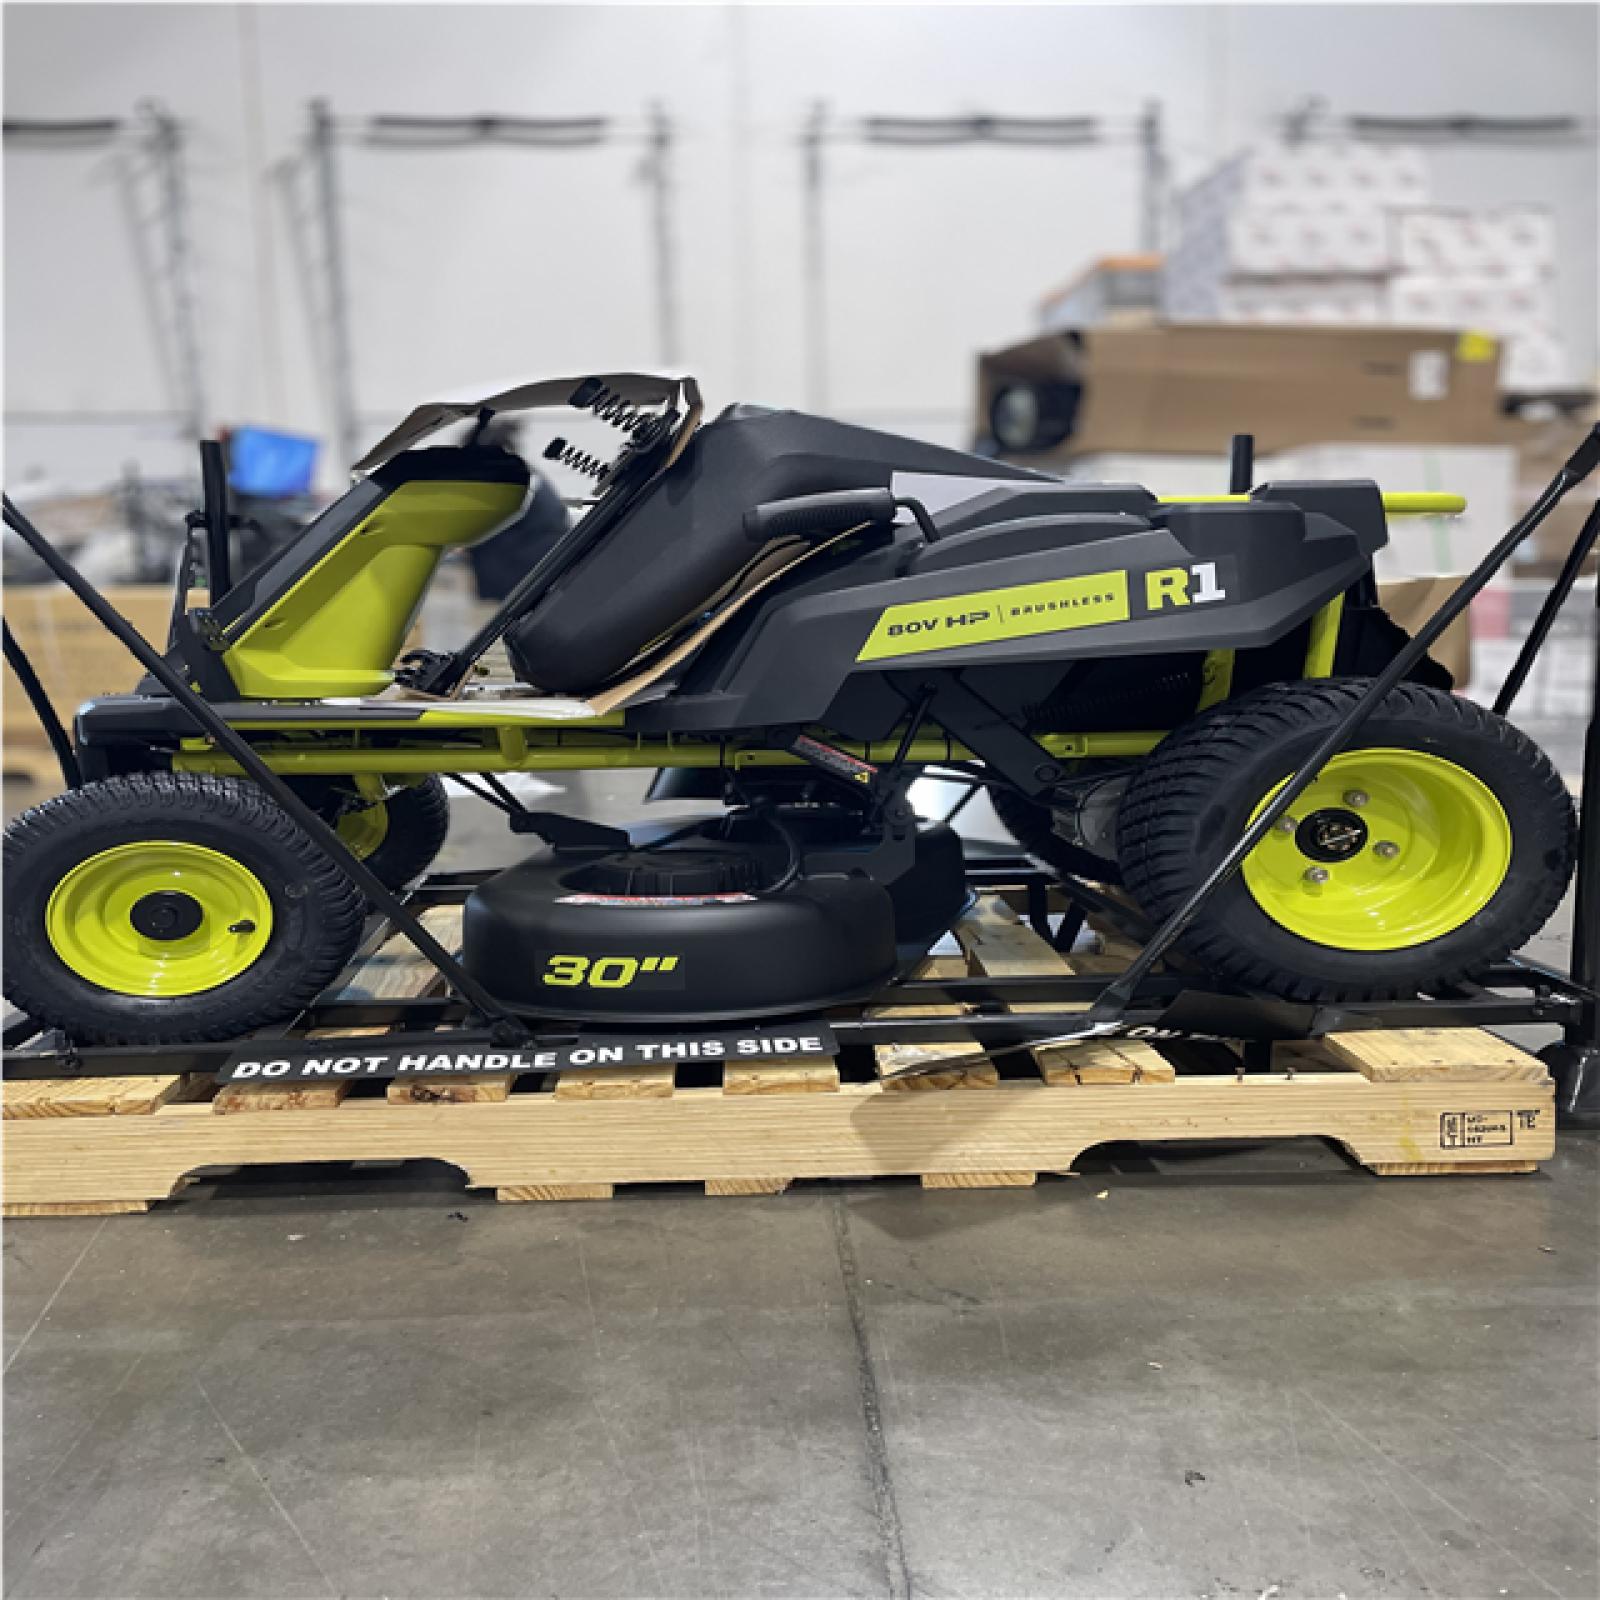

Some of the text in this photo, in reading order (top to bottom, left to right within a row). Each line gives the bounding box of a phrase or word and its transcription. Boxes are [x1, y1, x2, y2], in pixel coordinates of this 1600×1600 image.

[887, 593, 1115, 636] 80V HP BRUSHLESS
[232, 1036, 823, 1078] DO NOT HANDLE ON THIS SIDE
